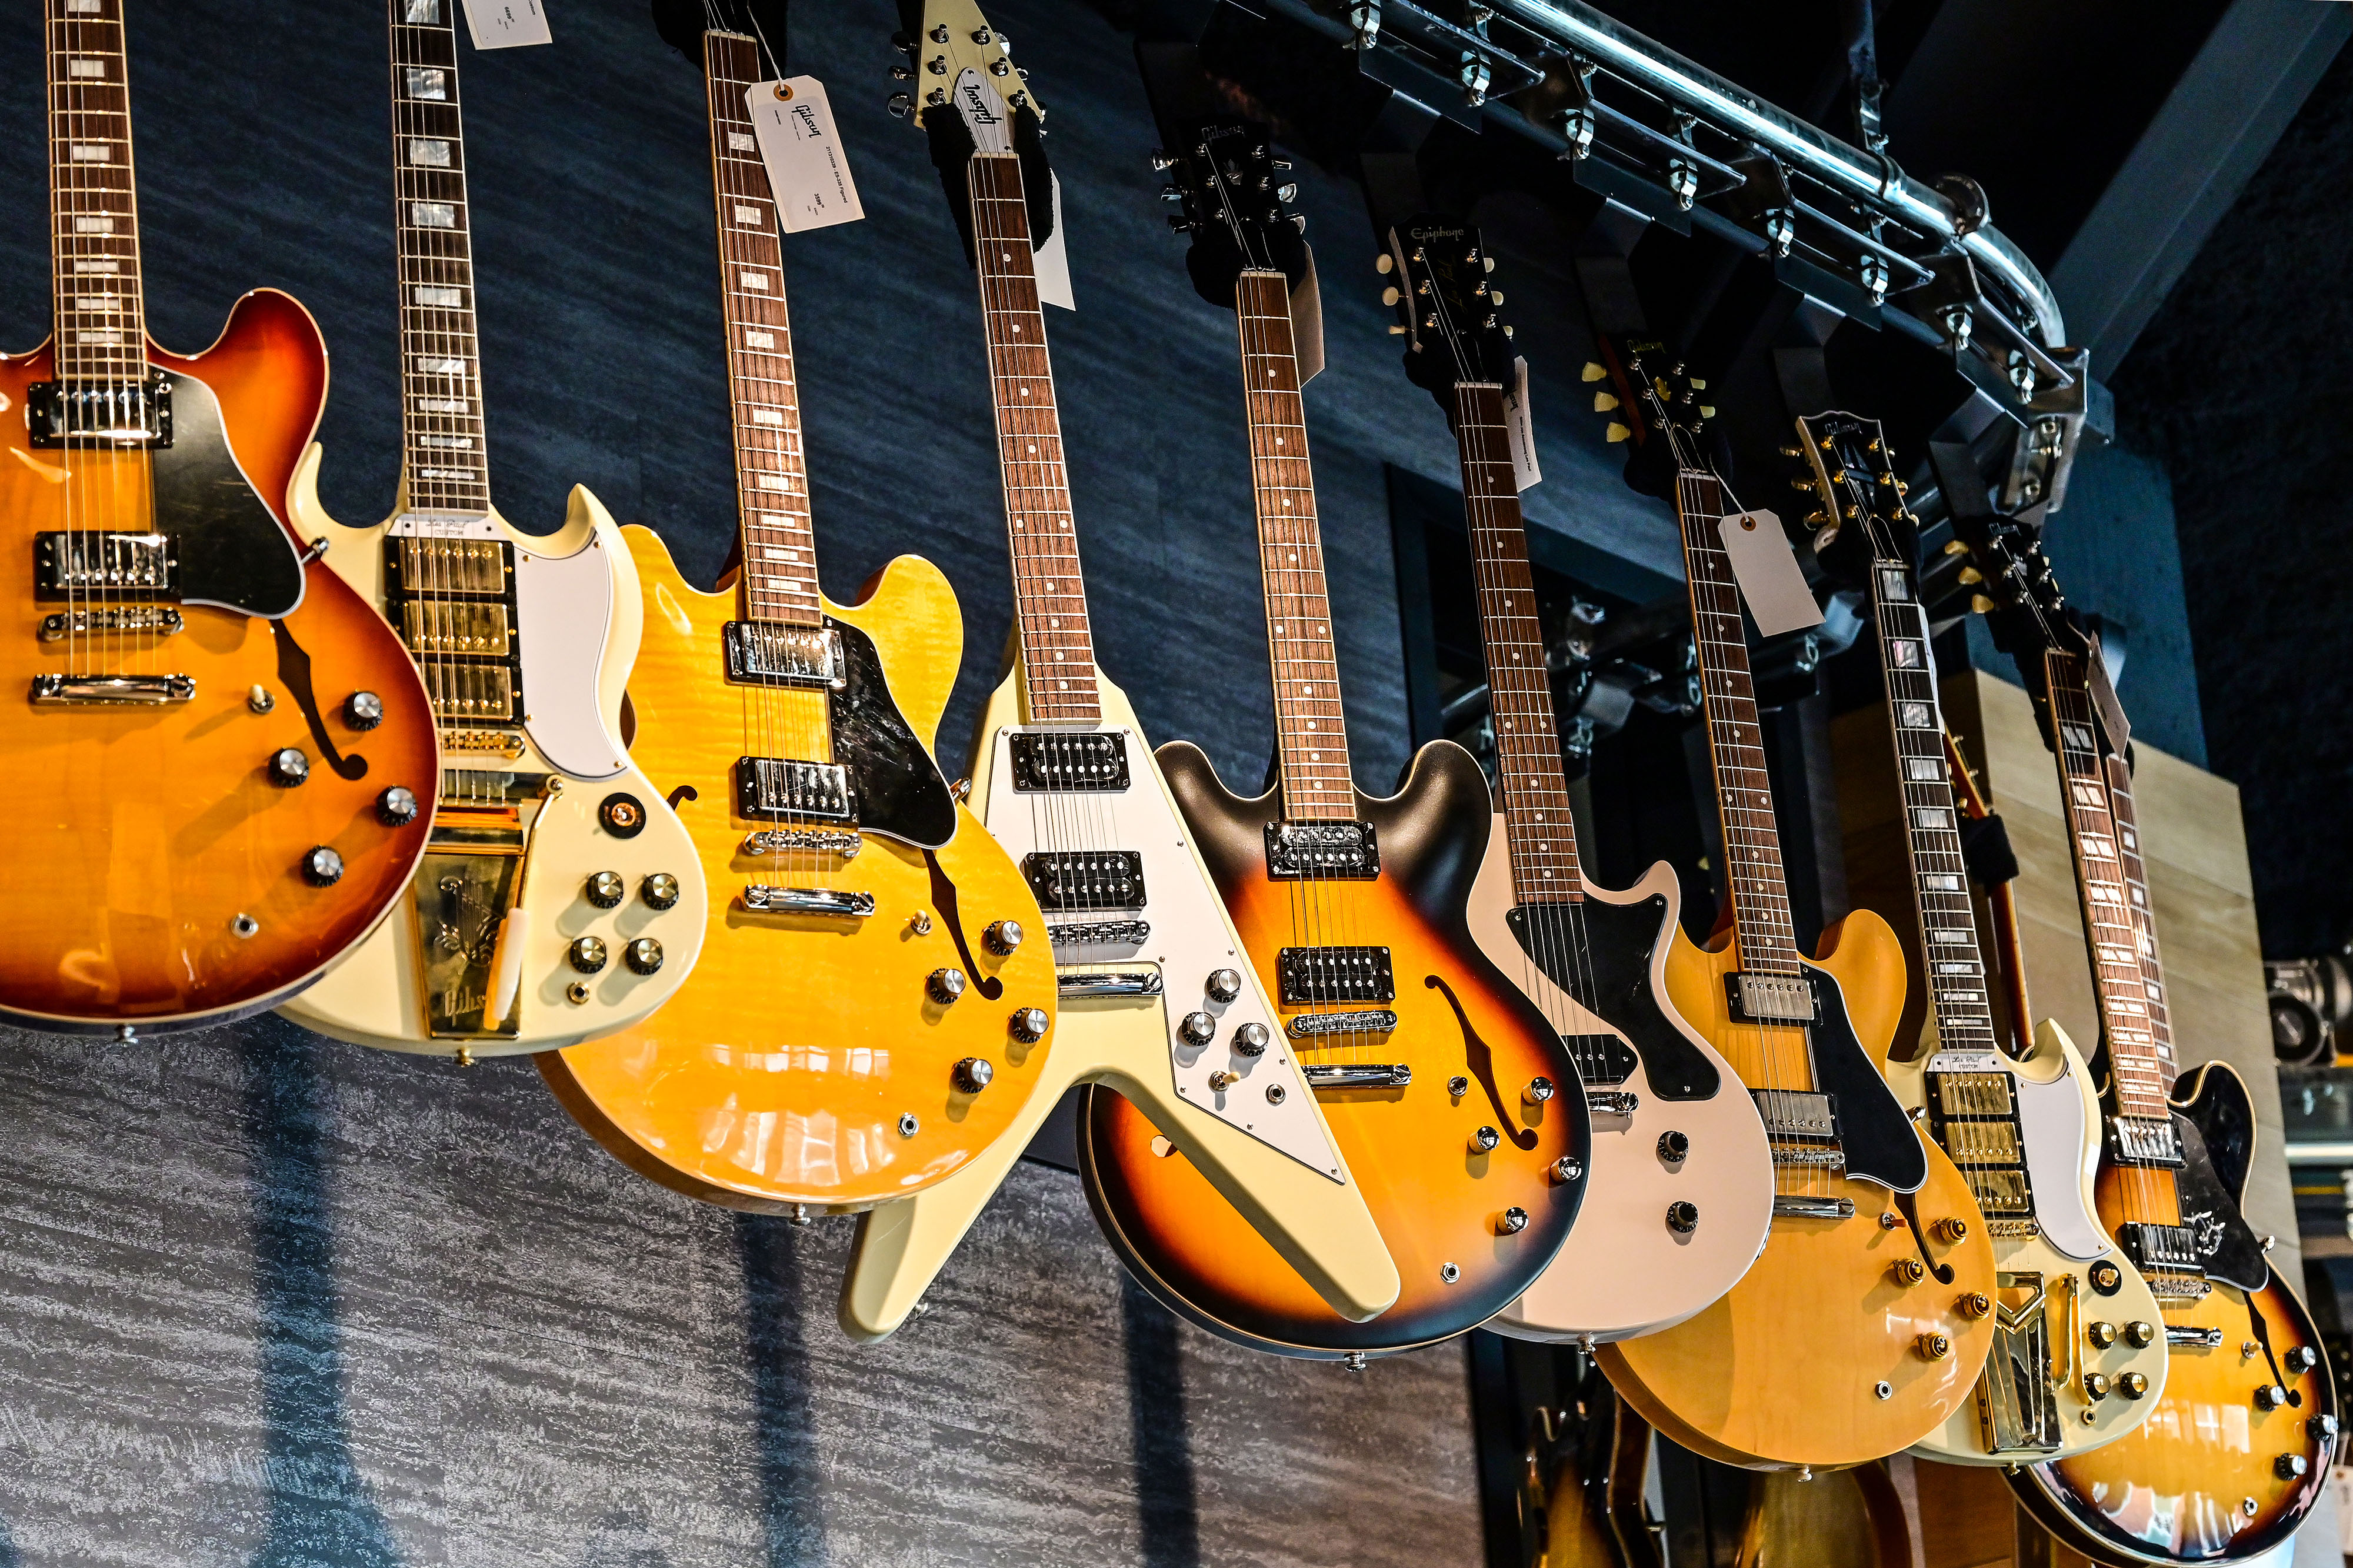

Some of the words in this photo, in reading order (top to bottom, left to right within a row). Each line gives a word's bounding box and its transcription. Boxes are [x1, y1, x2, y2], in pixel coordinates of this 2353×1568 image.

[963, 84, 1002, 124] Gibson
[791, 104, 822, 138] Gibson
[1202, 125, 1247, 146] Gibson
[826, 146, 837, 168] 211310339
[834, 171, 843, 186] ES-335
[839, 186, 848, 203] Figured
[814, 192, 822, 205] 3599
[1411, 226, 1464, 243] Epiphone
[445, 518, 469, 528] Paul
[445, 986, 487, 1027] Gibs
